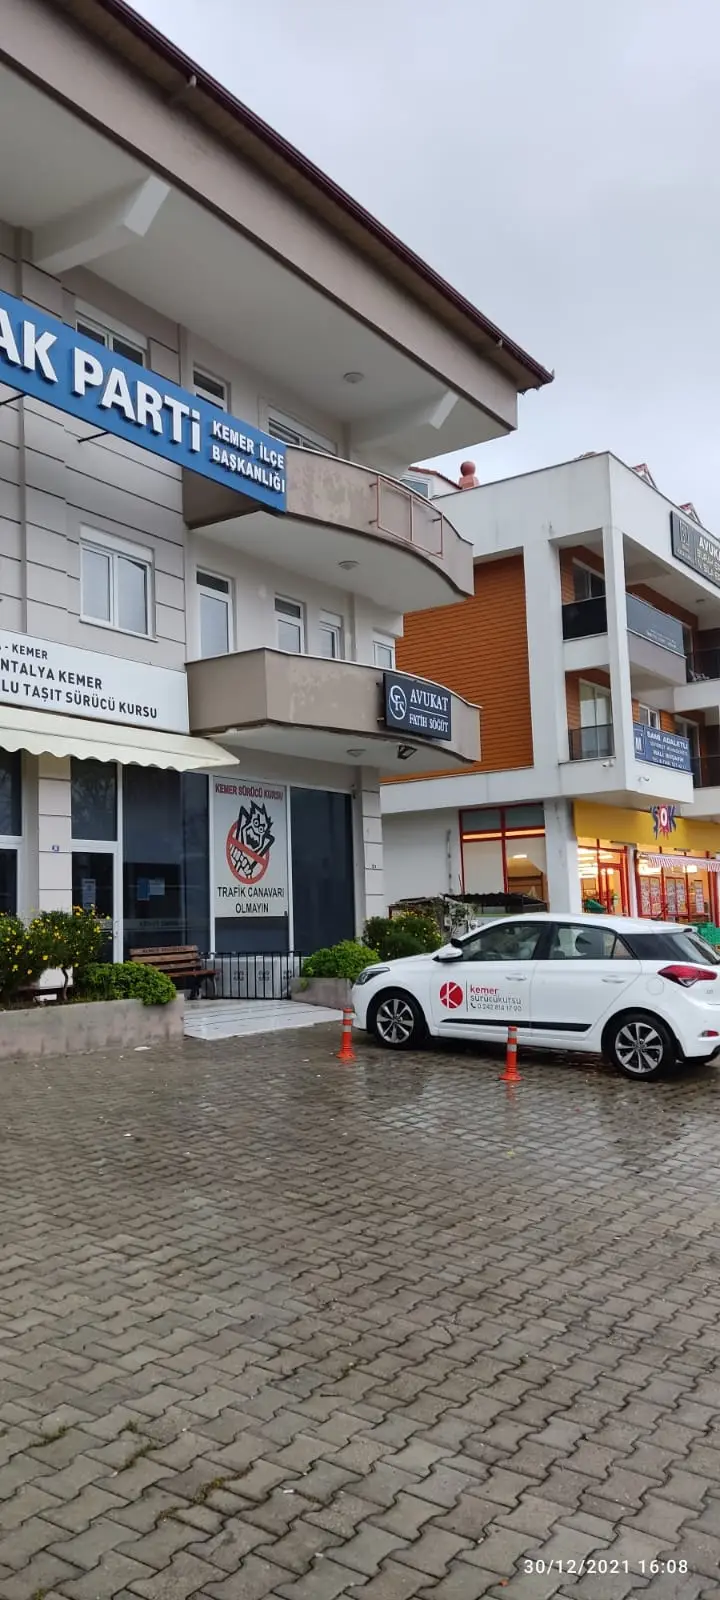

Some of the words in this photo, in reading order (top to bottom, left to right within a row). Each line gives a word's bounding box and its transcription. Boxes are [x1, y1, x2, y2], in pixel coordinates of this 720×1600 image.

[0, 307, 58, 384] AK
[211, 420, 255, 457] KEMER
[259, 441, 285, 471] İLÇE
[211, 444, 286, 495] BAŞKANLIĞI
[12, 643, 48, 660] KEMER
[58, 670, 102, 690] KEMER
[23, 683, 62, 703] TAŞIT
[66, 690, 115, 711] SÜRÜCÜ
[119, 702, 157, 719] KURSU
[410, 688, 449, 711] AVUKAT
[215, 783, 237, 795] KEMER
[238, 785, 263, 798] SÜRÜCÜ
[217, 884, 246, 898] TRAFİK
[247, 886, 284, 898] CANAVARI
[235, 903, 269, 914] OLMAYIN
[470, 984, 498, 995] kemer
